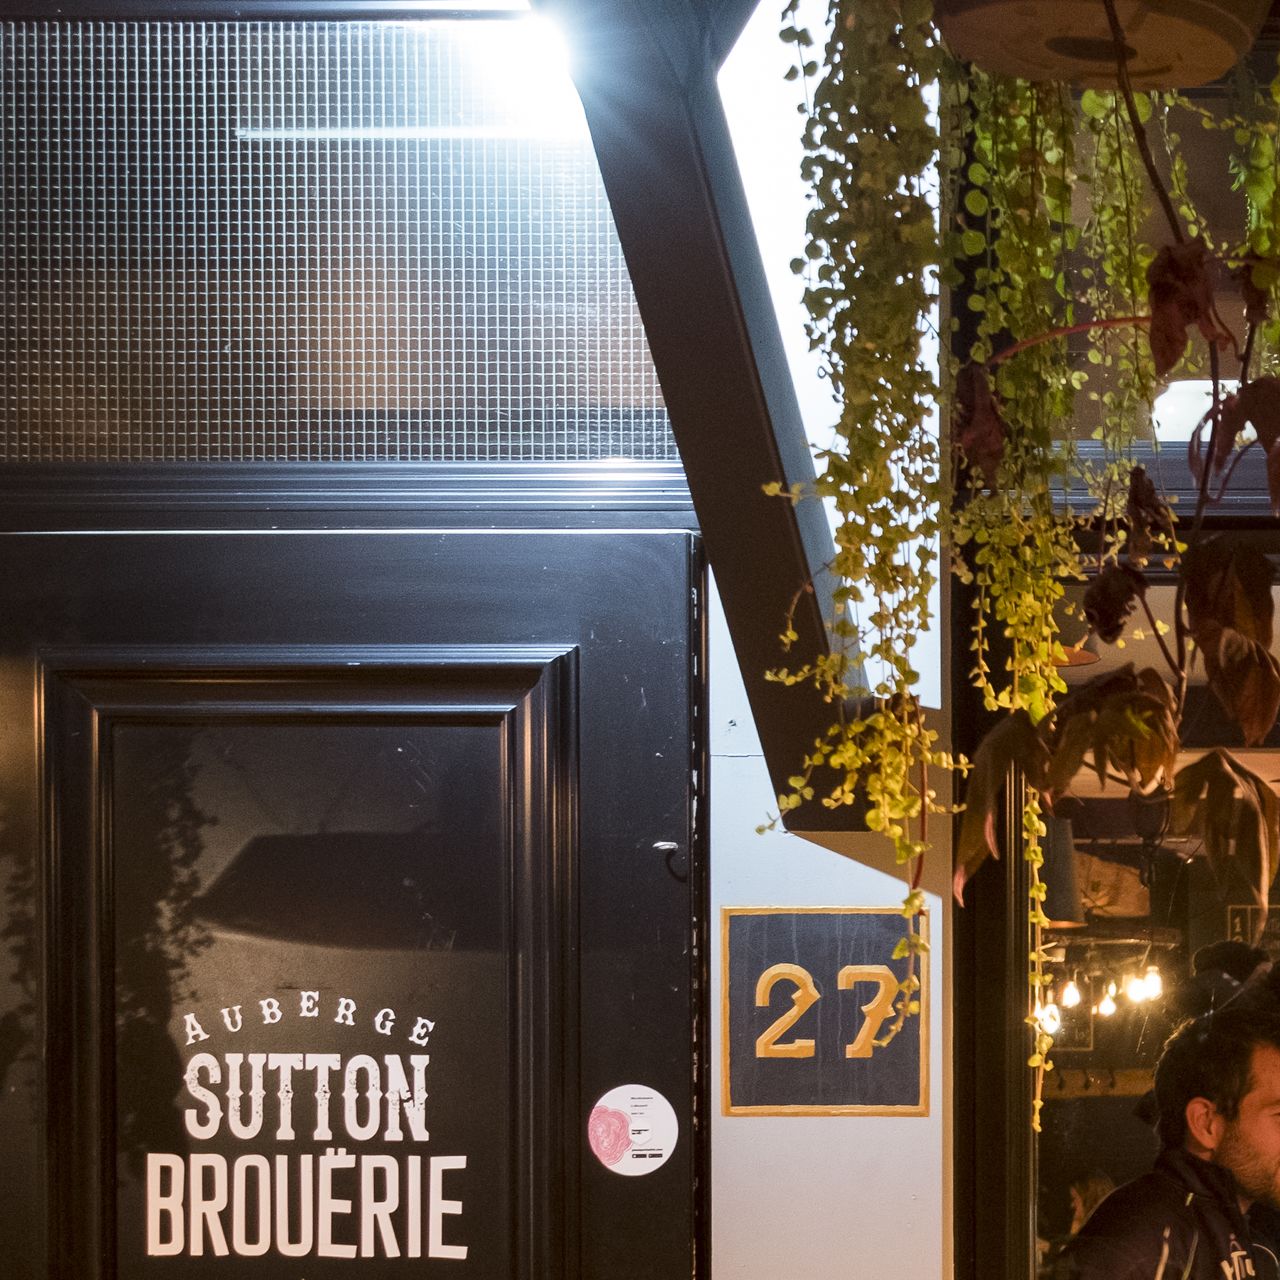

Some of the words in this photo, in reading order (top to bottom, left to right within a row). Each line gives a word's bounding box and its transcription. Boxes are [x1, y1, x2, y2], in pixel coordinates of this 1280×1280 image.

[181, 989, 438, 1046] AUBERGE
[755, 963, 899, 1059] 27
[182, 1052, 430, 1142] SUTTON
[146, 1147, 469, 1260] BROUËRIE
